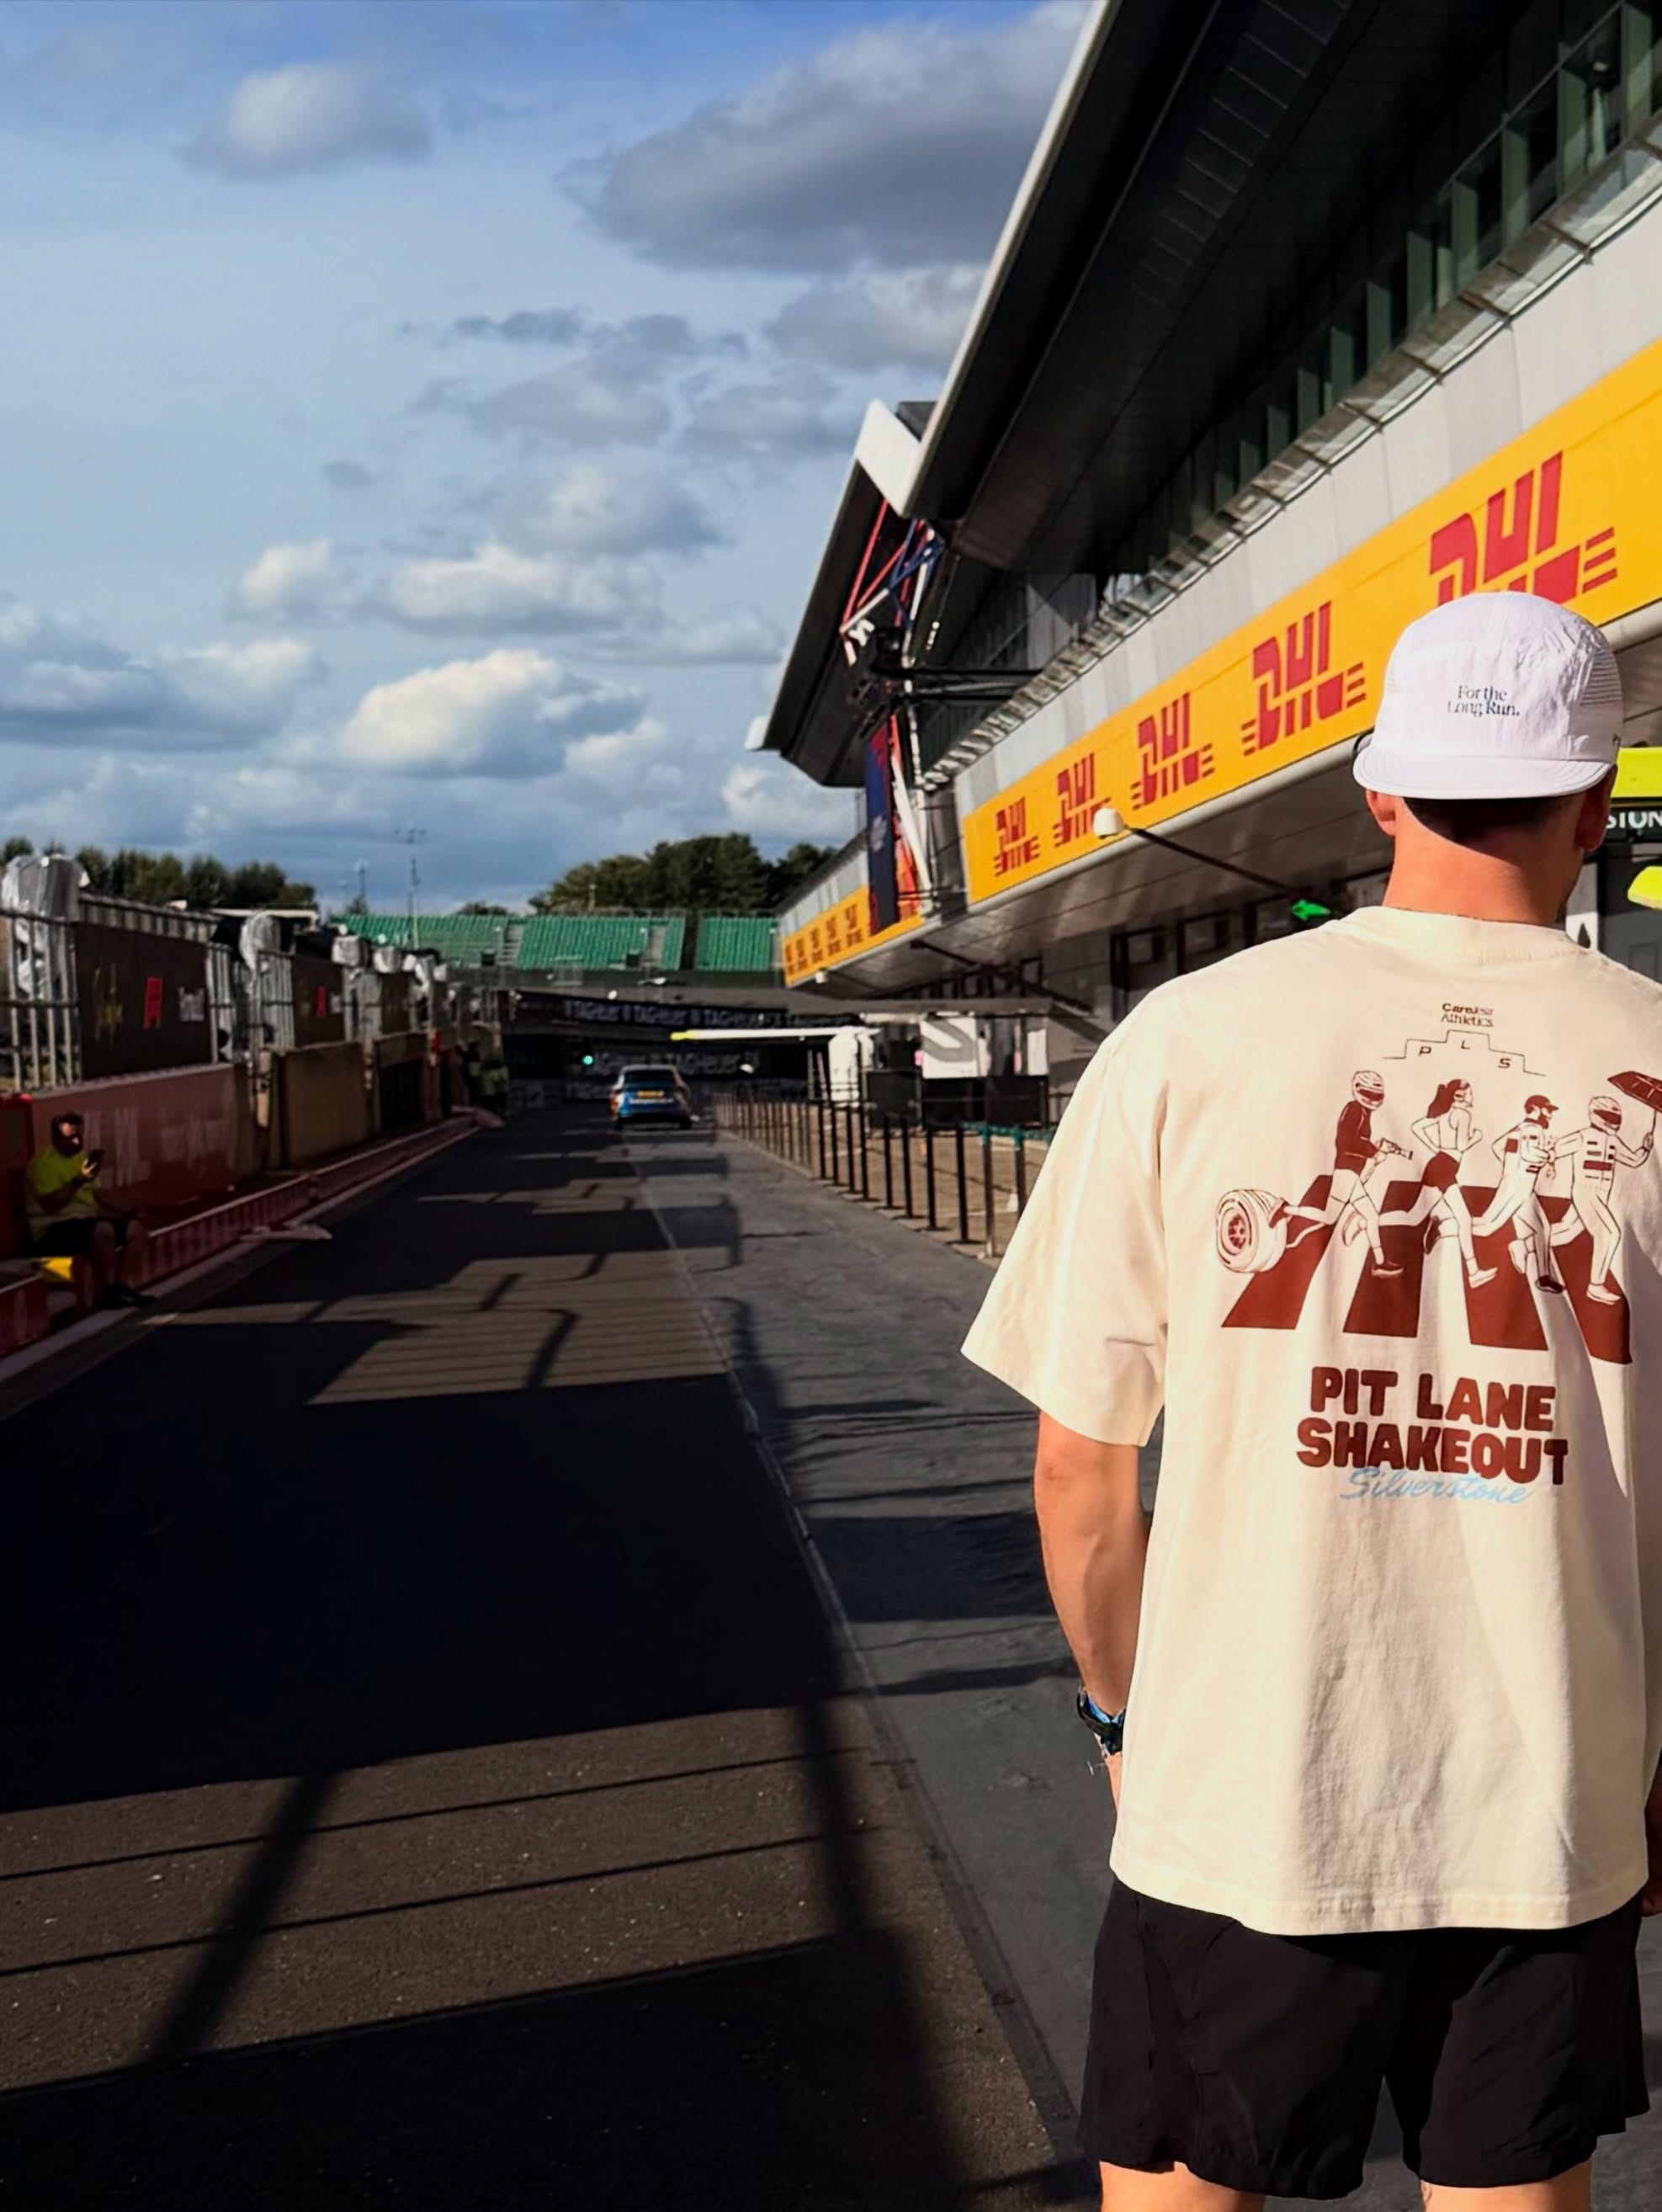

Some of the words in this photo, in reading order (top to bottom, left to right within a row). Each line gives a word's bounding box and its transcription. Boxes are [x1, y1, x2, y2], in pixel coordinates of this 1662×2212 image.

[1252, 600, 1345, 751] DHL
[1447, 700, 1483, 717] Long
[1485, 699, 1520, 716] Run.
[1458, 685, 1481, 699] For
[1484, 685, 1507, 701] the
[1138, 692, 1200, 807] DHL
[996, 797, 1031, 872] DHL
[1419, 1046, 1432, 1056] P
[1461, 1040, 1471, 1050] L
[1498, 1058, 1511, 1069] S
[1310, 1366, 1399, 1417] PIT
[1416, 1373, 1556, 1432] LANE
[1296, 1417, 1569, 1486] SHAKEOUT
[1340, 1465, 1534, 1505] Silverstone
